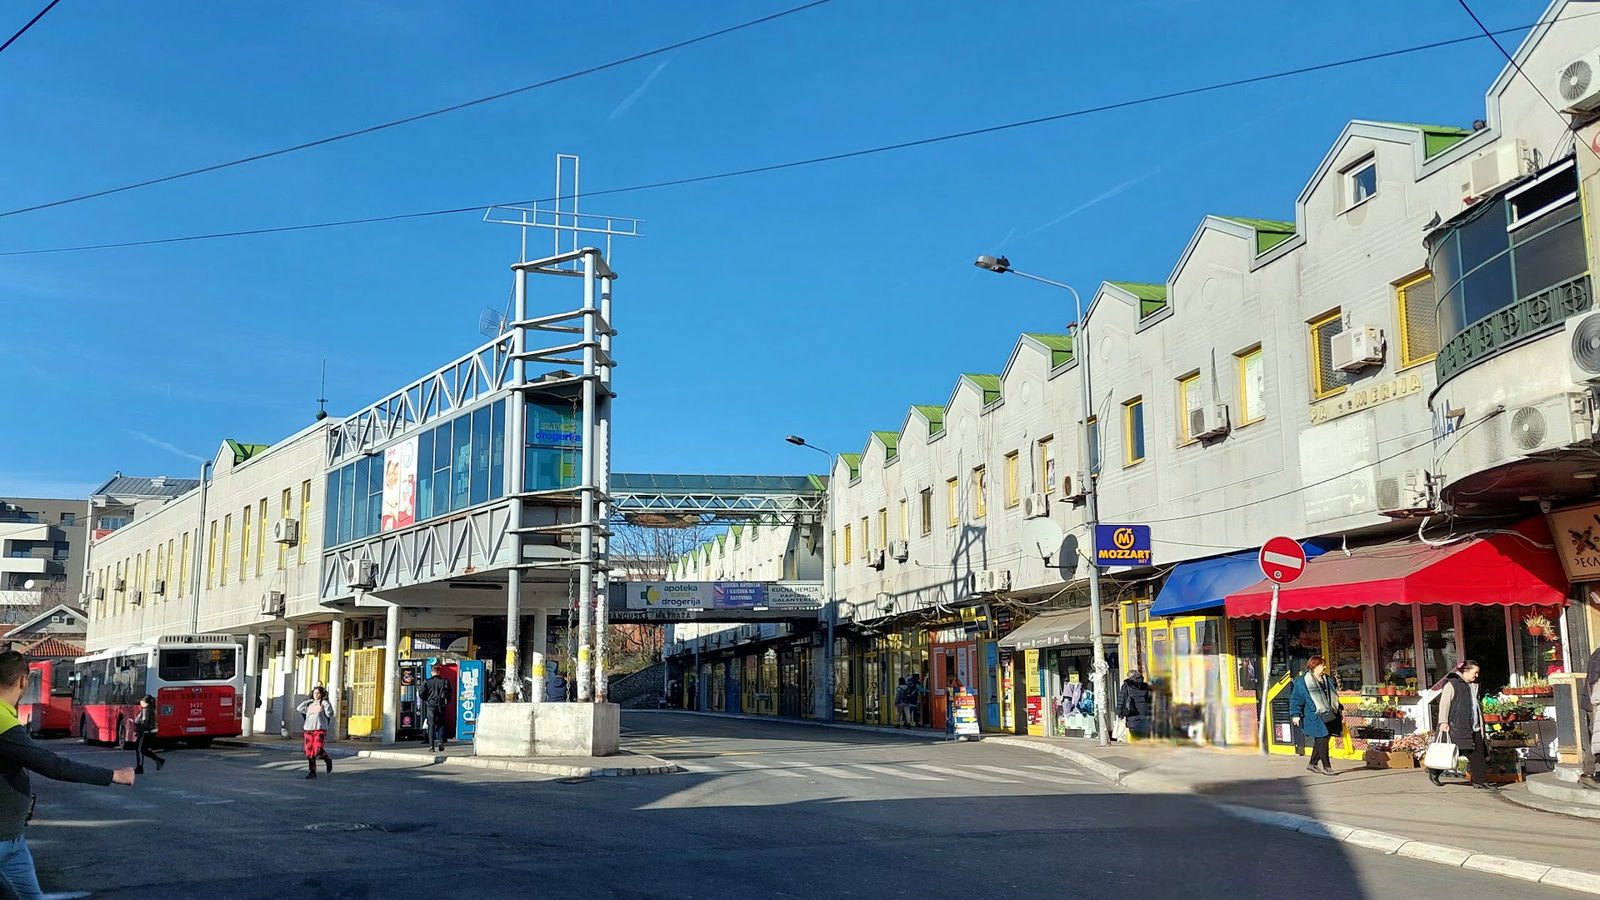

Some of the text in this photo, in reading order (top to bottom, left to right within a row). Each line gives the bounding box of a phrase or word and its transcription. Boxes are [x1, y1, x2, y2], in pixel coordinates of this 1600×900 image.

[1098, 549, 1150, 559] MOZZART
[663, 584, 698, 593] apoteka
[661, 597, 701, 606] drogerija
